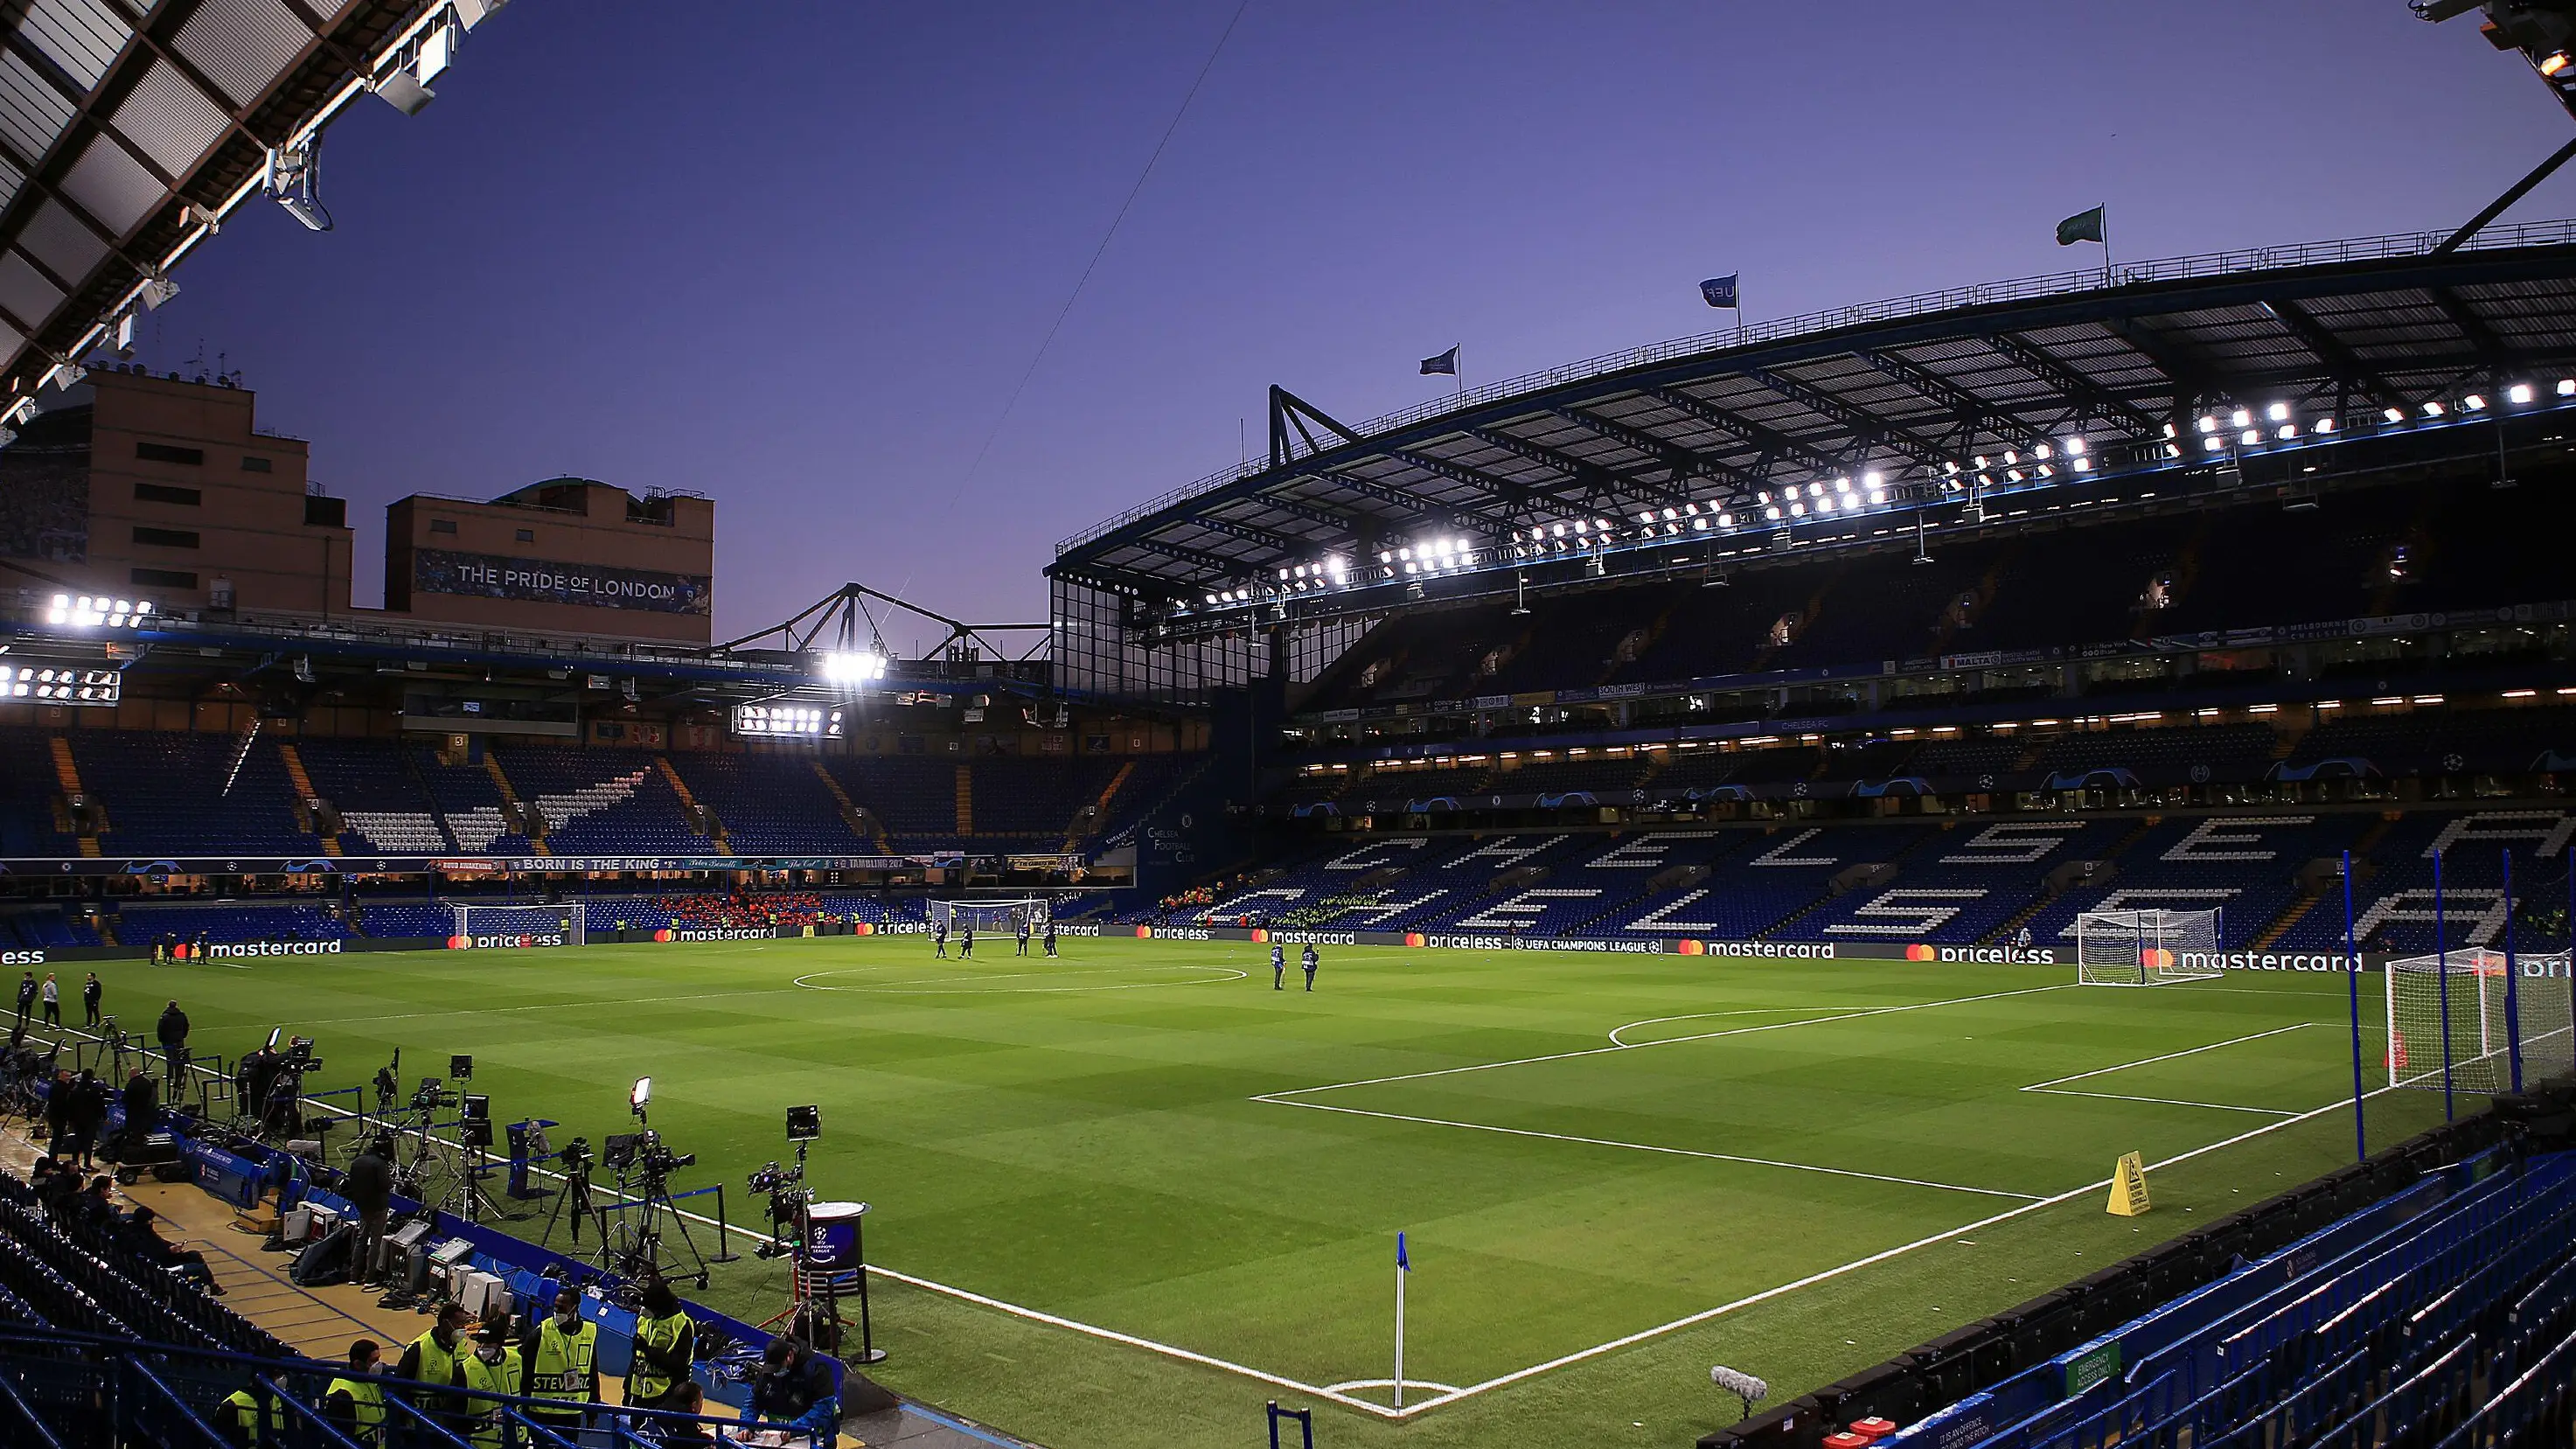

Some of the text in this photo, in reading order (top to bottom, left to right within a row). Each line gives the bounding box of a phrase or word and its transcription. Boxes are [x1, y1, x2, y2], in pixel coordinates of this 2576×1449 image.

[457, 565, 675, 600] THE PRIDE OF LONDON
[1957, 657, 1990, 666] MALTA
[1599, 685, 1624, 694] SOUTH
[1625, 683, 1646, 692] WEST
[1782, 721, 1817, 730] CHELSEA
[1105, 829, 1130, 845] CHELSEA
[523, 859, 659, 870] BORN IS THE KING
[1153, 926, 1209, 940] priceless
[1271, 930, 1355, 945] mastercard
[210, 938, 342, 958] mastercard
[1429, 932, 1647, 953] priceless UEFA CHAMPIONS LEAGUE
[1708, 942, 1835, 960] mastercard
[2181, 950, 2364, 973] mastercard
[2078, 1351, 2109, 1376] EMERGENCY
[2077, 1362, 2111, 1390] ACCESS ONLY
[1939, 1416, 1982, 1445] IT IS AN OFFENCE
[1964, 1431, 1974, 1443] THE
[1974, 1424, 1990, 1439] PITCH
